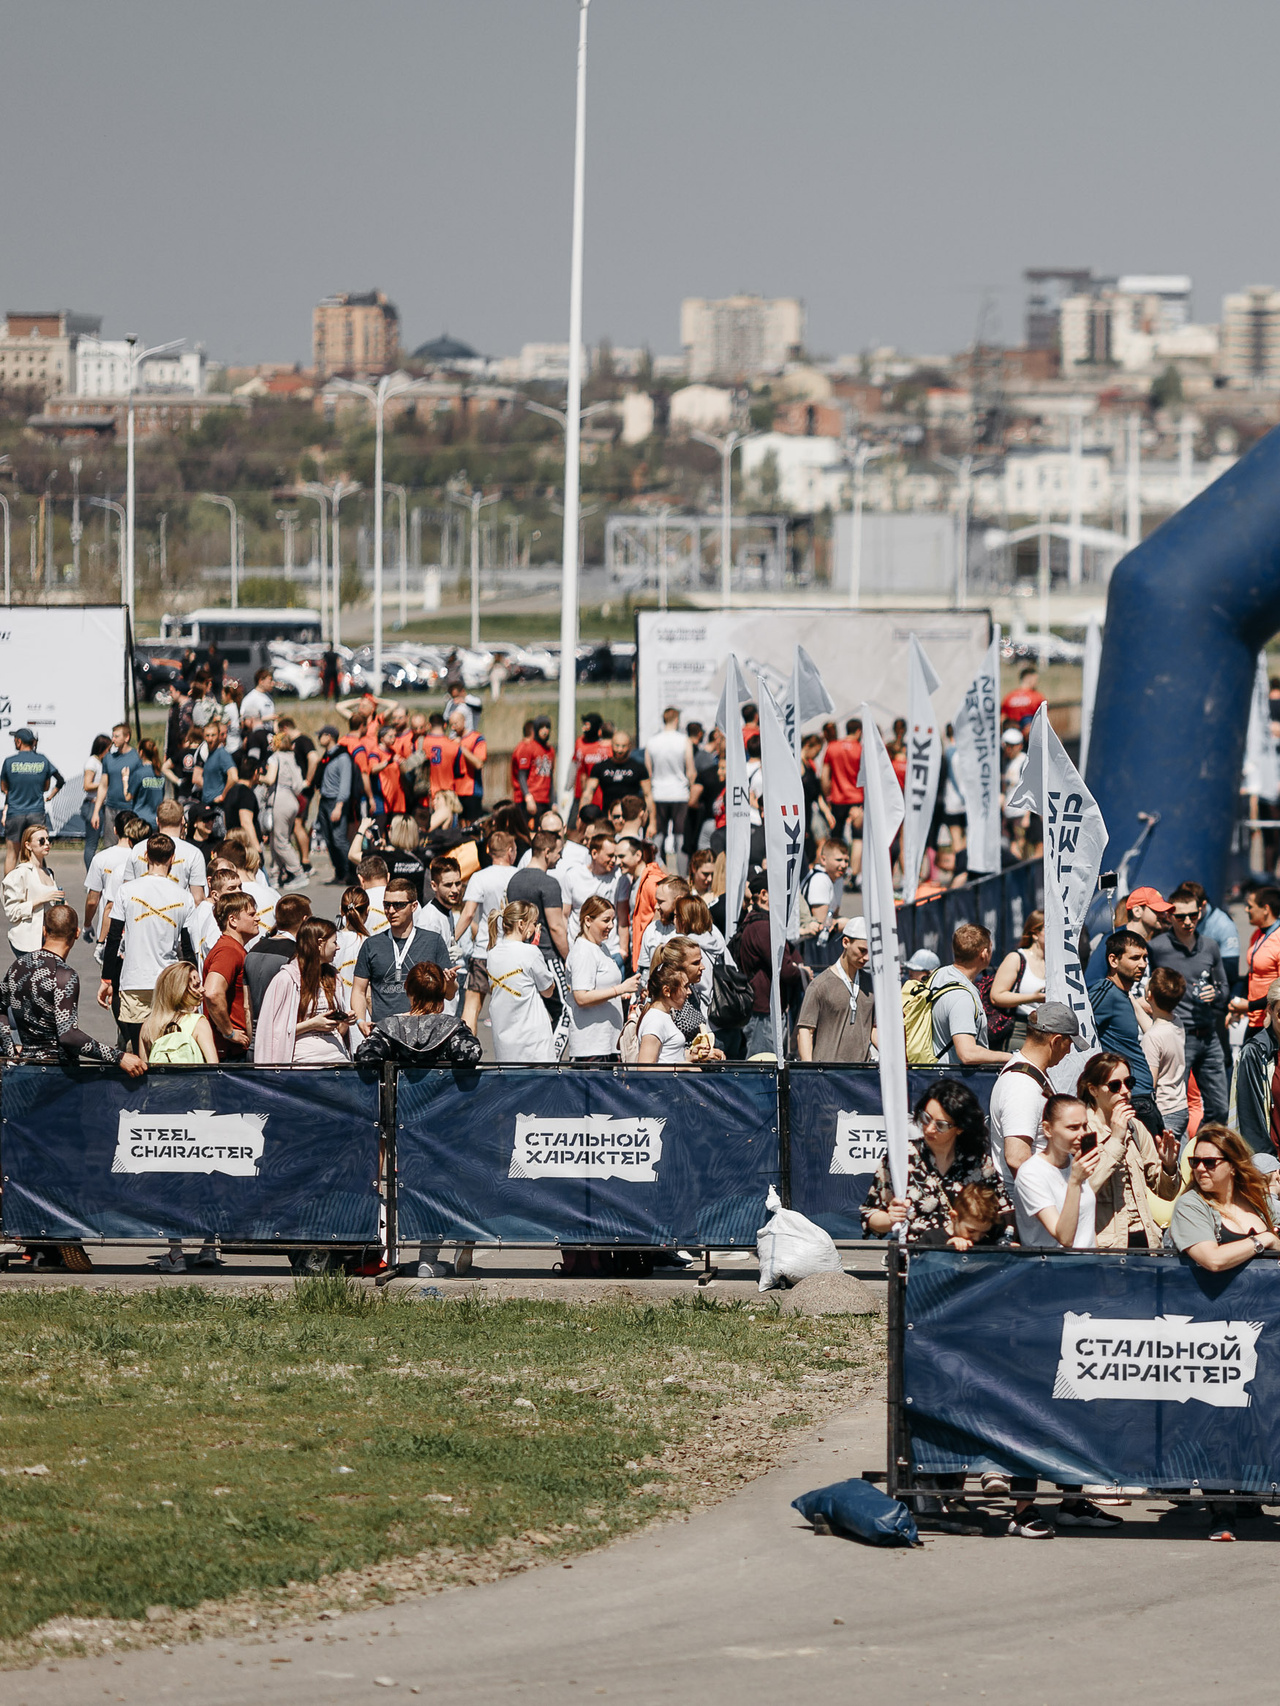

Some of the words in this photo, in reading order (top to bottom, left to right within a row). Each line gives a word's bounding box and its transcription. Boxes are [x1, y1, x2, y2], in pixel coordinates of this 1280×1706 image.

[430, 746, 443, 765] 3
[130, 1128, 197, 1142] STEEL
[524, 1127, 652, 1148] СТАЛЬНОЙ
[848, 1129, 887, 1142] STE
[130, 1144, 255, 1160] CHARACTER
[524, 1150, 652, 1167] ХАРАКТЕР
[1075, 1336, 1242, 1360] СТАЛЬНОЙ
[1077, 1362, 1242, 1384] ХАРАКТЕР
